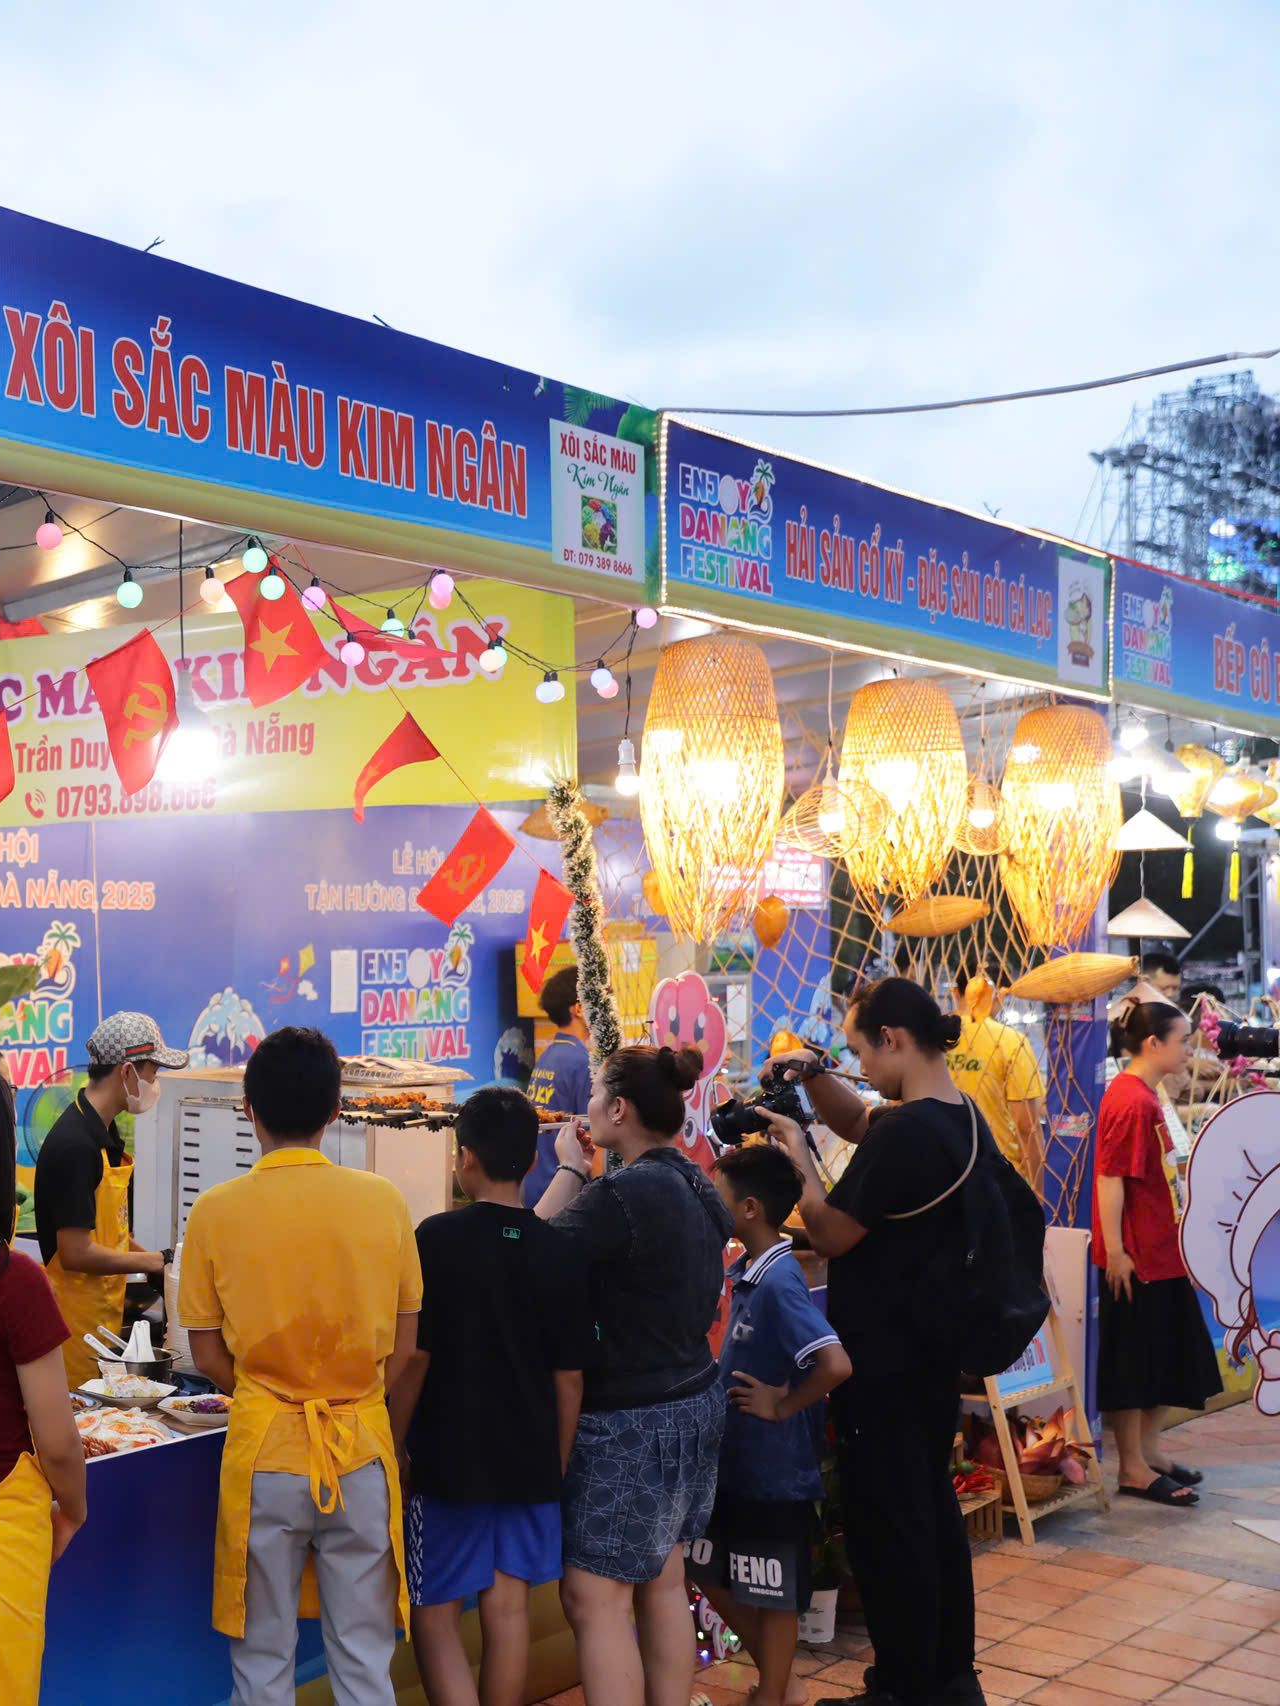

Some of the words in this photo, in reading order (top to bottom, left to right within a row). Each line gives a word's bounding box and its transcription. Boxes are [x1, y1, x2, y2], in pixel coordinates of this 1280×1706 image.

[3, 301, 97, 418] XÔI
[112, 316, 211, 443] SẮC
[224, 361, 325, 470] MÀU
[337, 396, 416, 492] KIM
[426, 420, 527, 519] NGÂN
[560, 431, 579, 459] XÔI
[584, 435, 606, 466] SẮC
[611, 446, 636, 474] MÀU
[567, 463, 595, 489] Kim
[598, 472, 629, 500] Ngân
[679, 503, 772, 556] DANANG
[578, 553, 594, 566] 079
[596, 557, 611, 571] 389
[613, 561, 632, 575] 8666
[680, 544, 774, 596] FESTIVAL
[785, 504, 816, 583] HẢI
[820, 514, 855, 593] SẢN
[884, 539, 905, 605] KÝ
[951, 551, 981, 624] SẢN
[174, 650, 247, 701] KI
[15, 735, 62, 774] Trần
[246, 712, 315, 757] Nẵng
[101, 880, 156, 910] 2025
[361, 987, 470, 1027] DANANG
[362, 1025, 470, 1061] FESTIVAL
[729, 1552, 783, 1588] FENO
